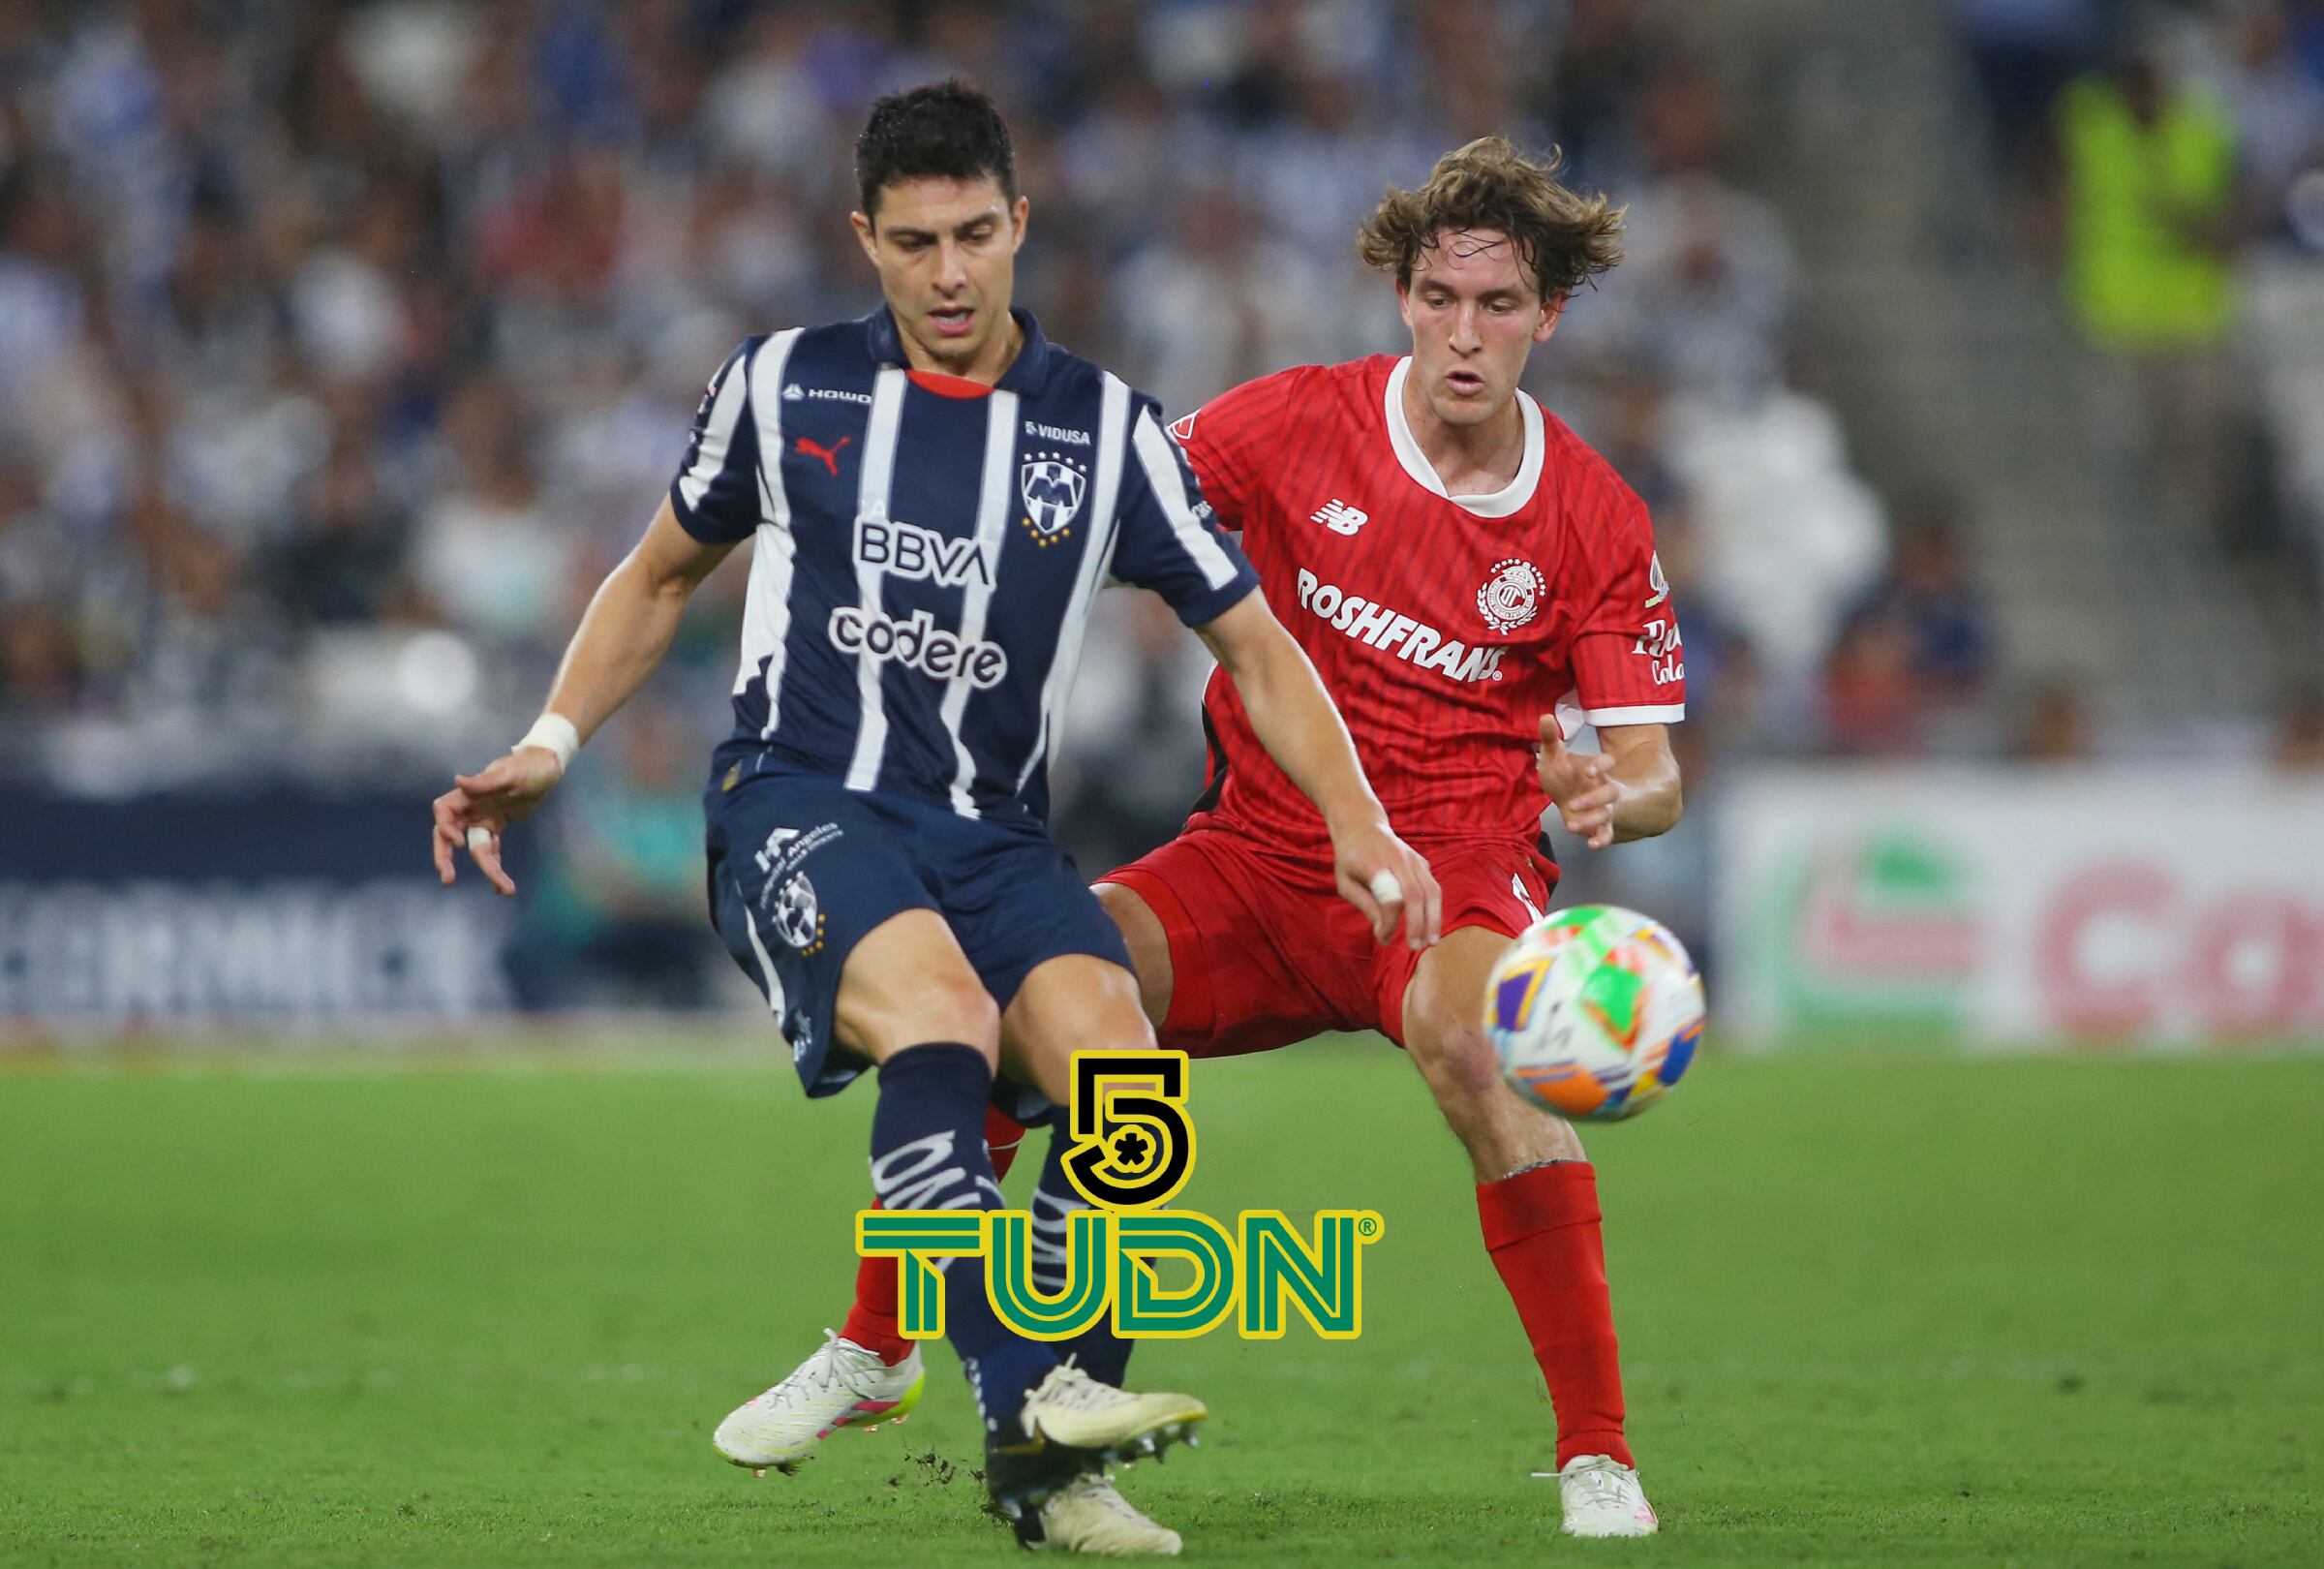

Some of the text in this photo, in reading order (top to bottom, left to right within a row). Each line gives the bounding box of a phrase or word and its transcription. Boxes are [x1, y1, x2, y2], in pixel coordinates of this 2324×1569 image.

[809, 388, 872, 404] HOWO
[1038, 423, 1091, 446] VIDUSA
[857, 520, 993, 589] BBVA
[834, 613, 1004, 686] codere
[1652, 654, 1686, 686] Cola
